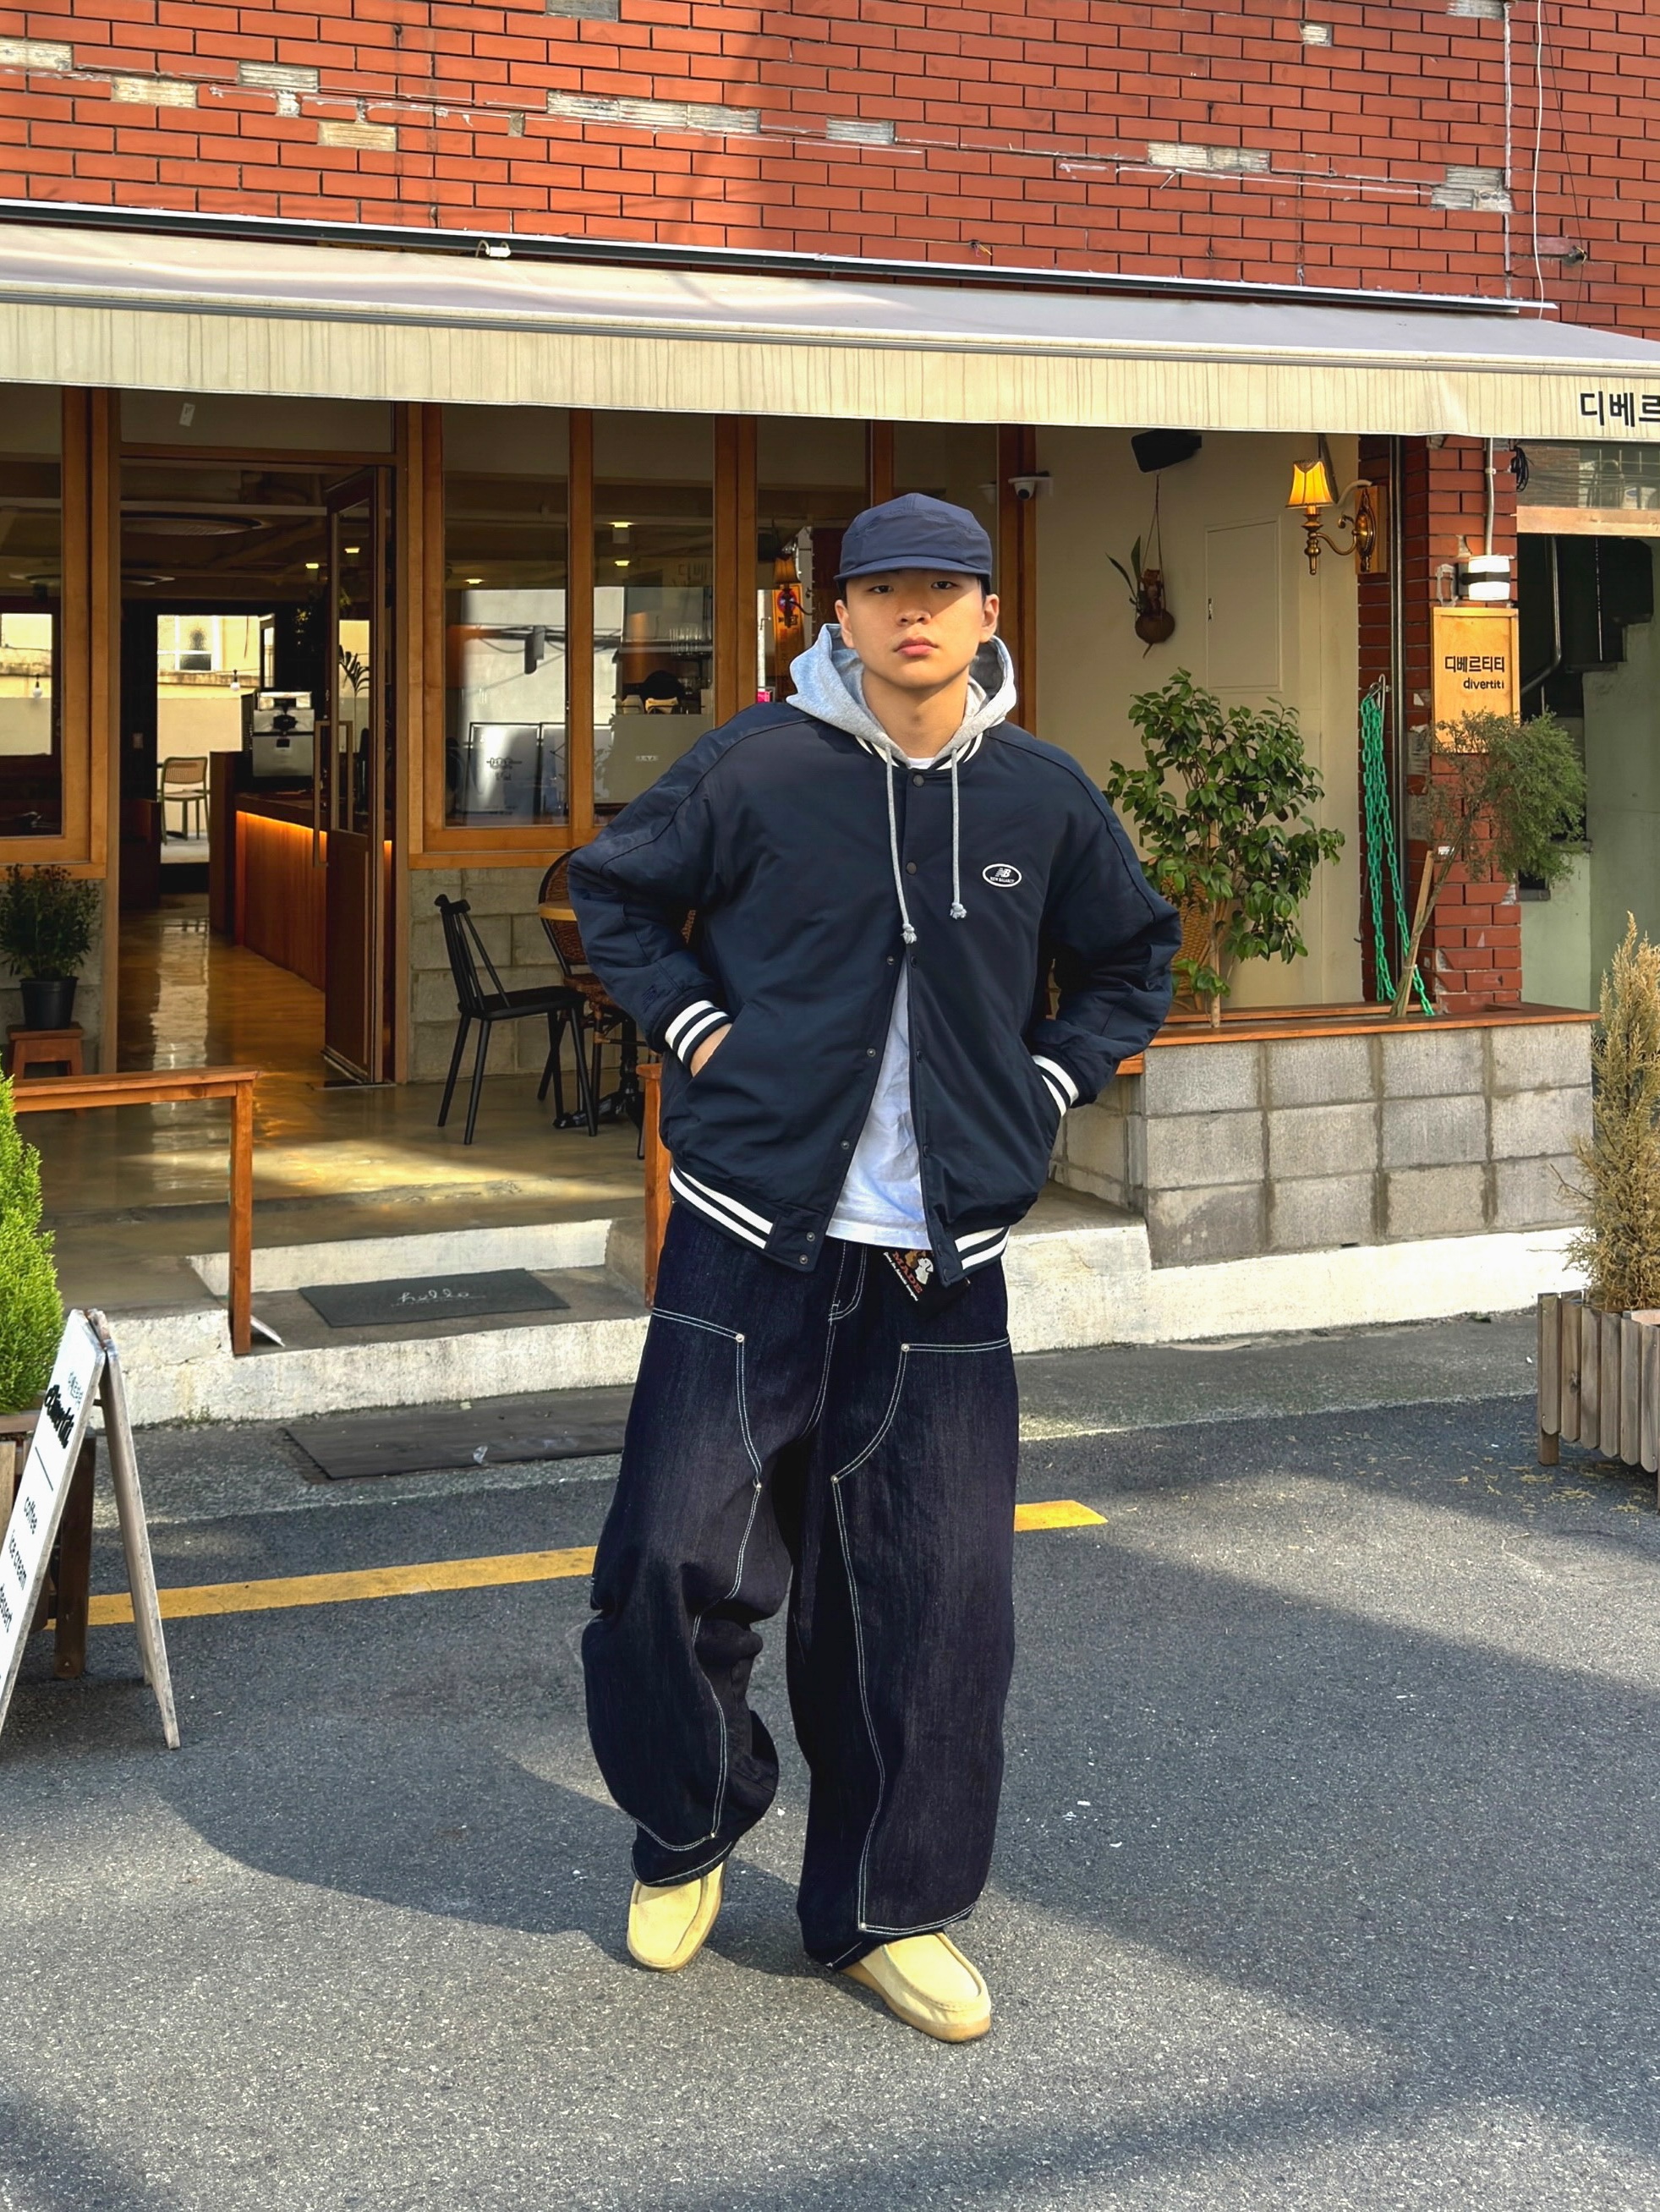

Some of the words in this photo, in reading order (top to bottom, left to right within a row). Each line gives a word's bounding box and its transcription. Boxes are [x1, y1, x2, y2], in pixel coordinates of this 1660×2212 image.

[1444, 655, 1504, 673] 디베르티티
[1463, 677, 1504, 689] divertiti
[397, 1288, 469, 1303] hello
[24, 1496, 38, 1535] coffee
[8, 1529, 17, 1559] ice
[14, 1550, 27, 1591] cream
